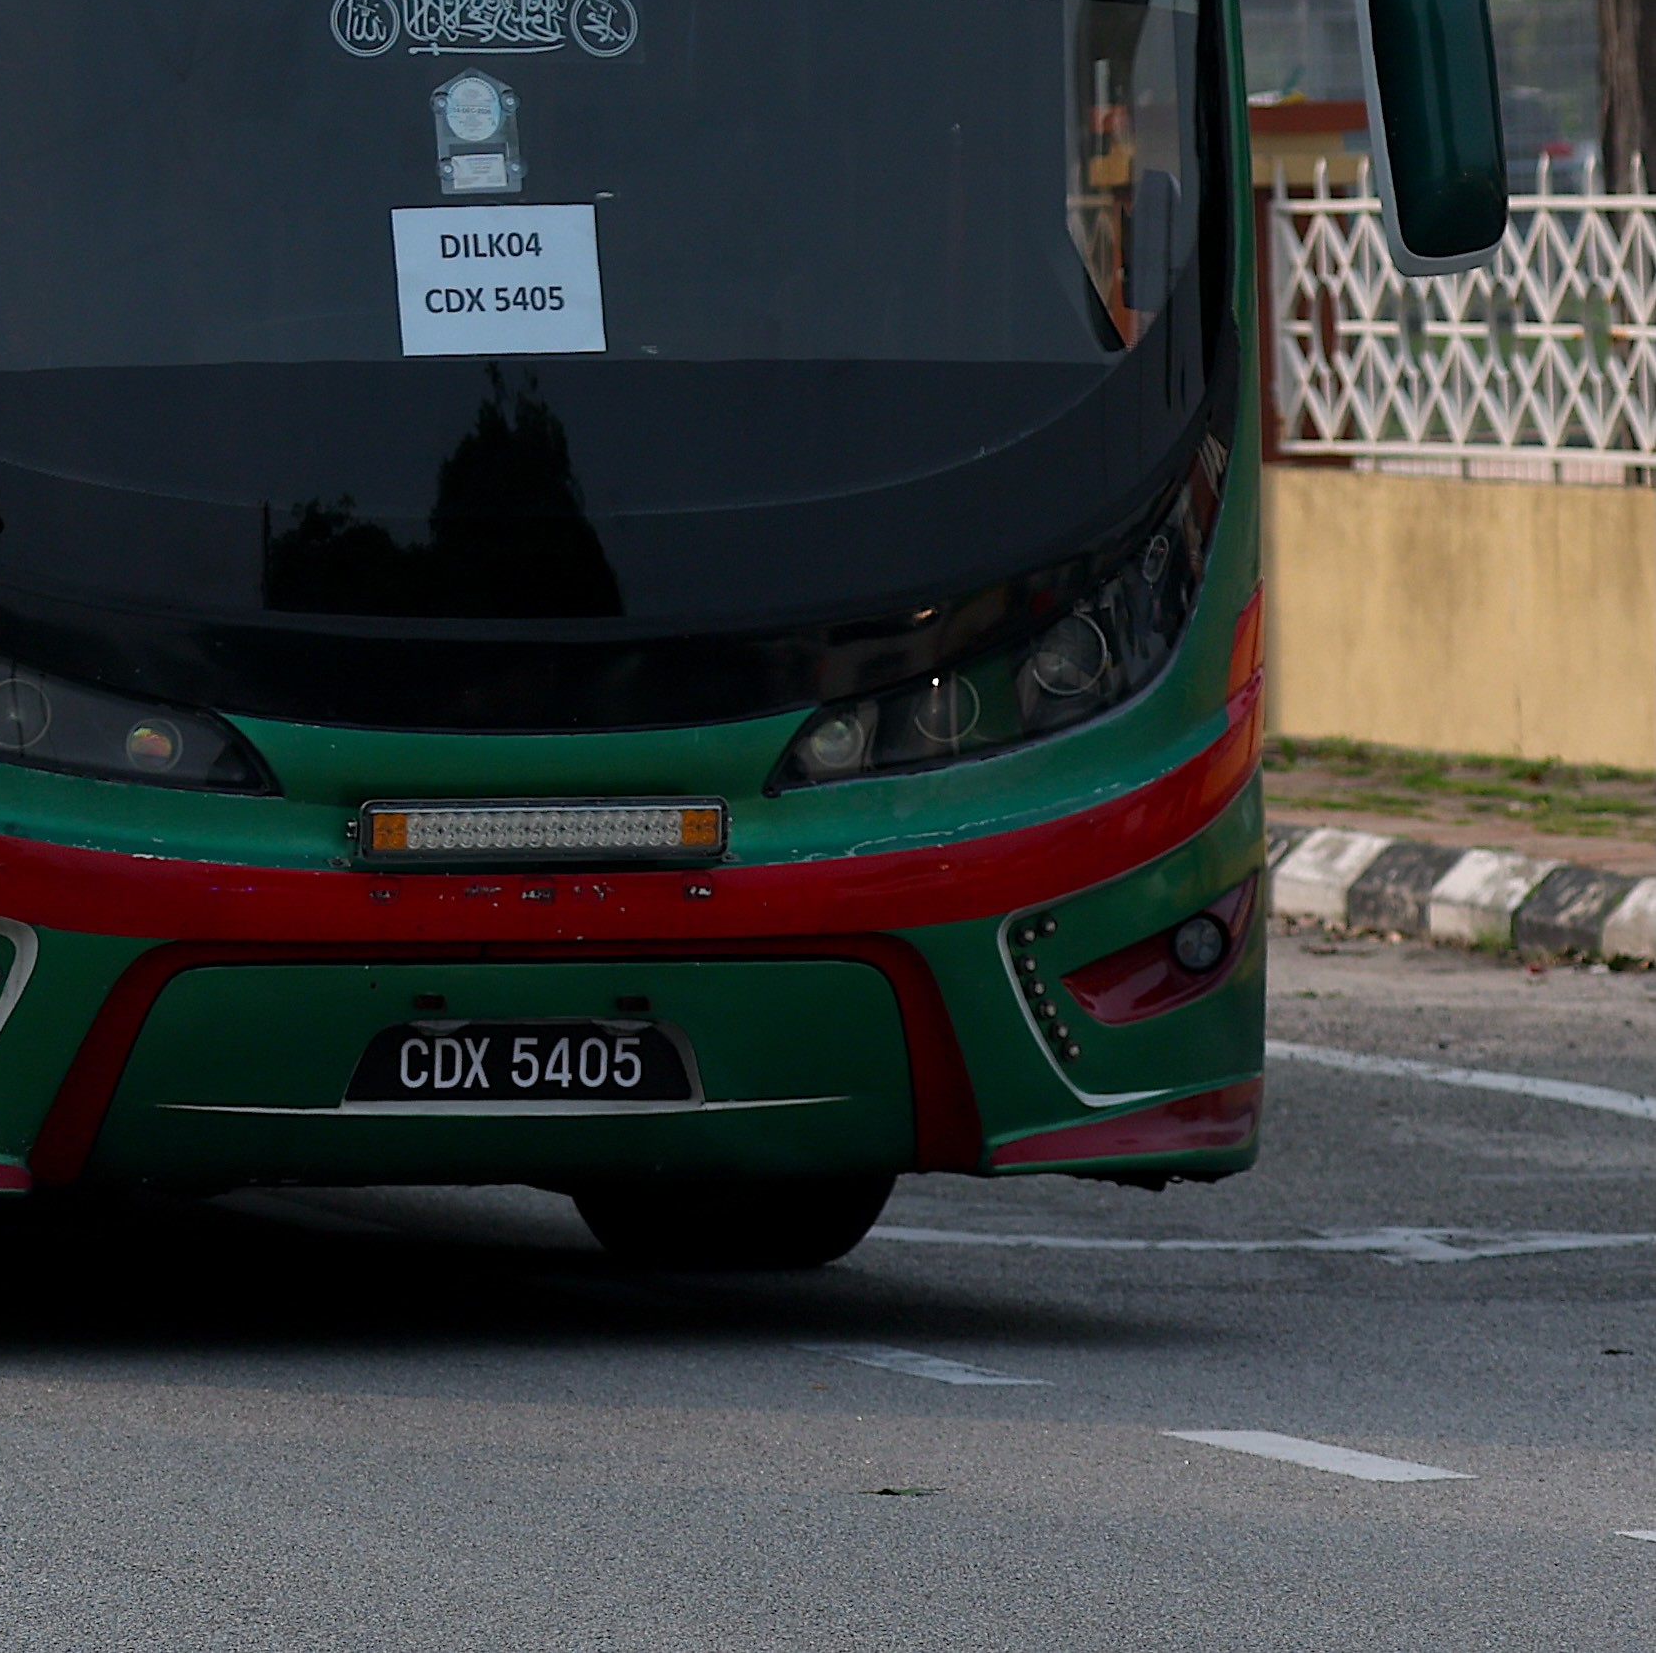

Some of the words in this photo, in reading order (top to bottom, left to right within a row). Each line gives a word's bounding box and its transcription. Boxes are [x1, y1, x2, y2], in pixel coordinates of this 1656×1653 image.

[440, 232, 543, 259] DILK04
[424, 287, 487, 313] CDX
[494, 286, 565, 312] 5405
[399, 1036, 491, 1089] CDX
[511, 1036, 643, 1089] 5405
